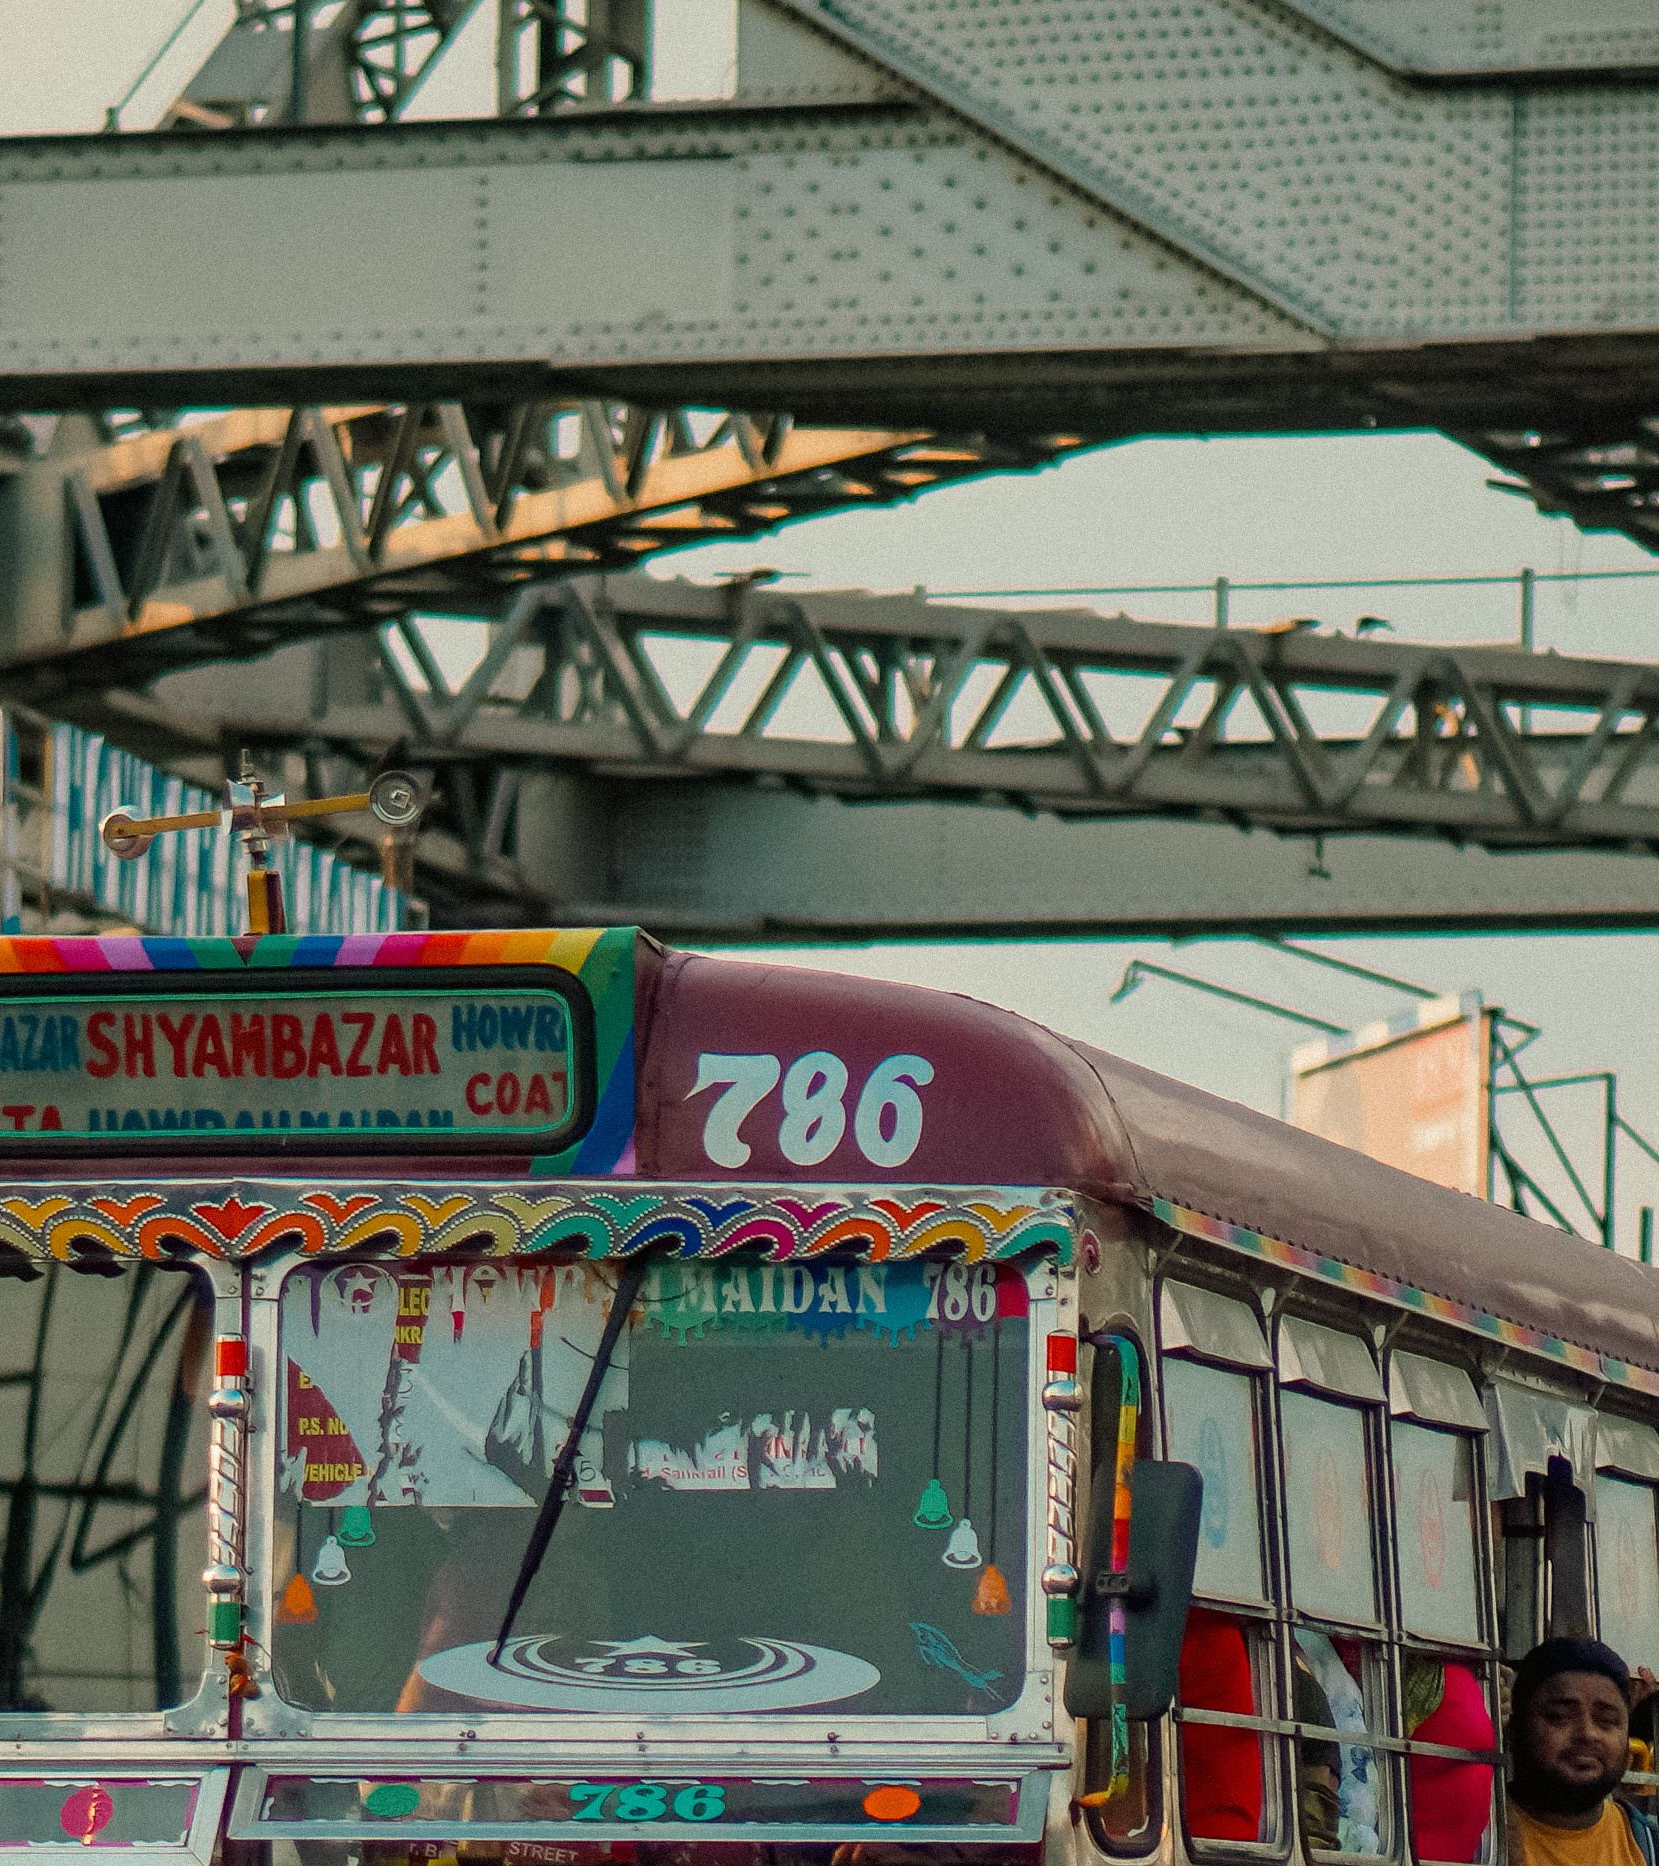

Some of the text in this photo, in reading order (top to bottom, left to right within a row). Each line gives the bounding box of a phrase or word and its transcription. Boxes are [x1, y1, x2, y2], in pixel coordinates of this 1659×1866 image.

[85, 1011, 442, 1080] SHYAMBAZAR
[692, 1051, 937, 1170] 786
[923, 1261, 997, 1322] 786
[573, 1656, 722, 1675] 786
[569, 1783, 727, 1822] 786
